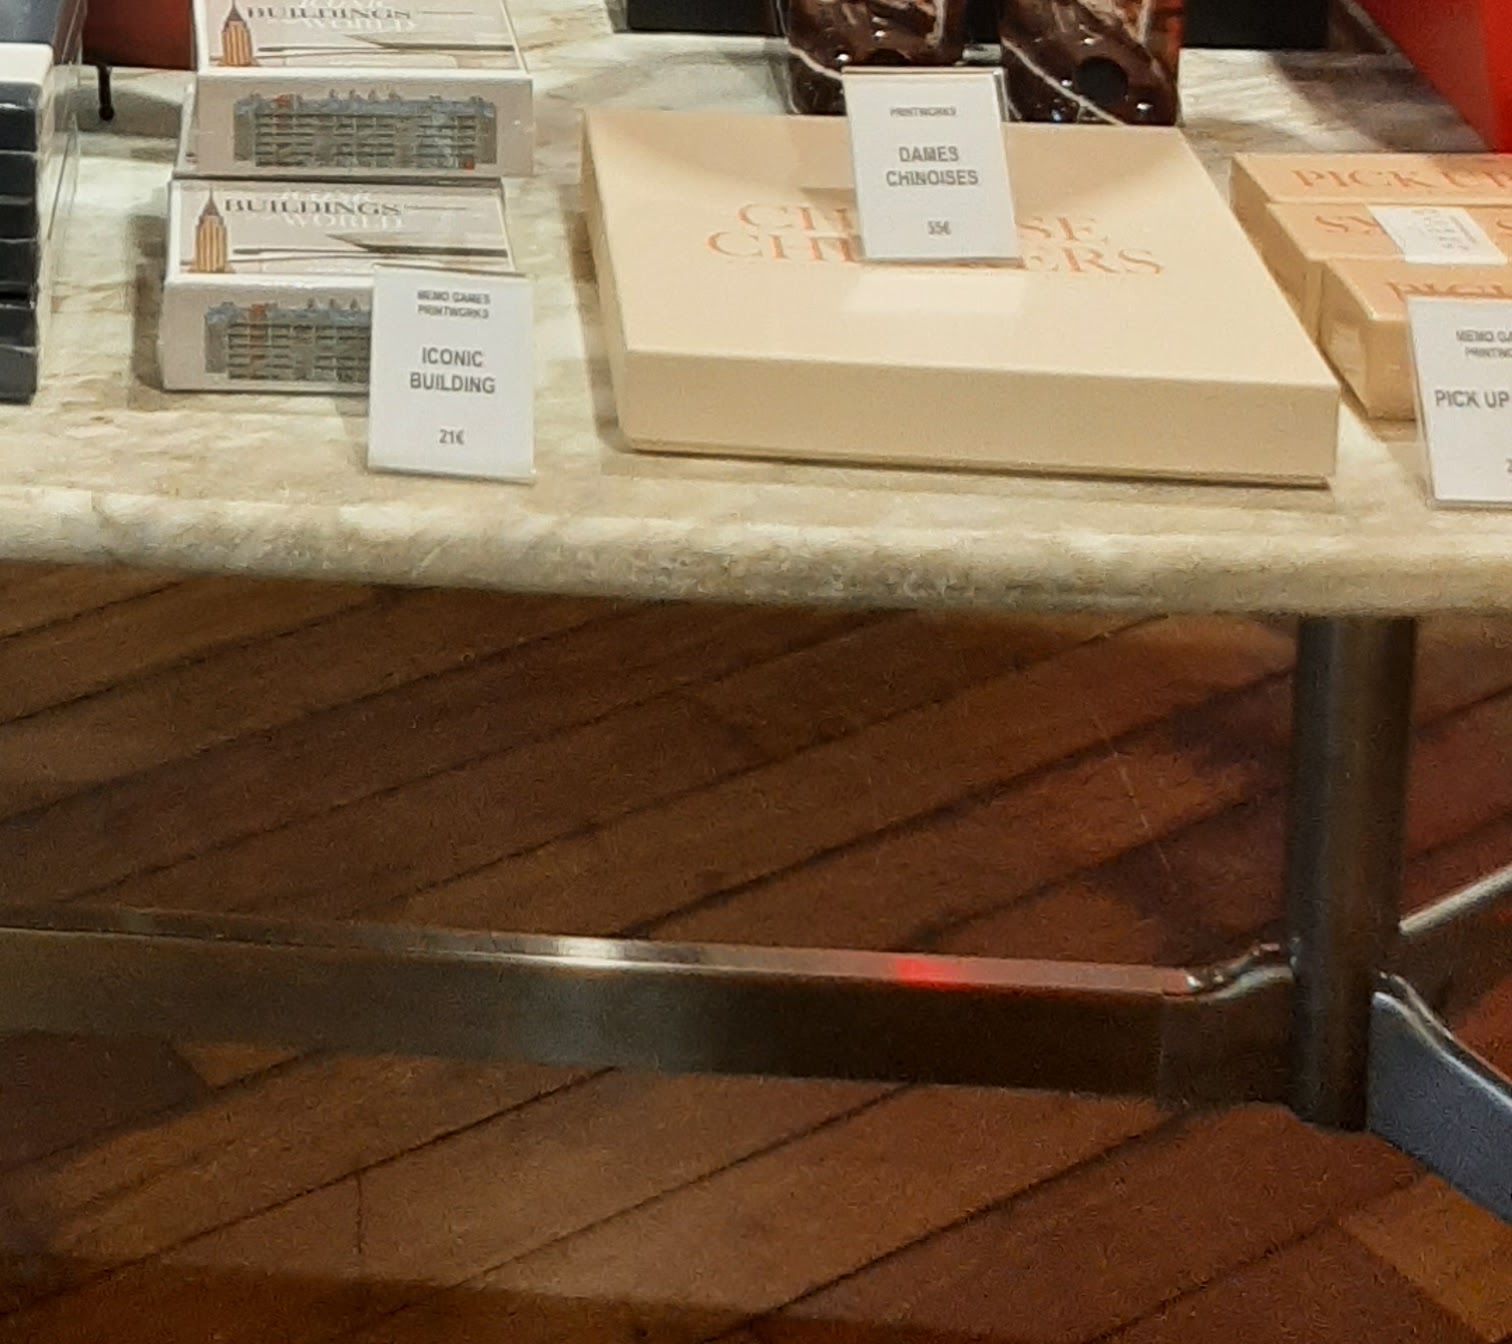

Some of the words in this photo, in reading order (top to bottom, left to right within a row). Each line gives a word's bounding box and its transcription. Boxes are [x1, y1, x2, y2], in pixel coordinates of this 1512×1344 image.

[246, 6, 412, 20] BUILDINGS
[898, 146, 960, 162] DAMES
[885, 169, 980, 187] CHINOISES
[1292, 169, 1438, 189] PICK
[223, 198, 402, 216] BUILDINGS
[421, 347, 484, 368] ICONIC
[409, 372, 496, 394] BUILDING
[1433, 388, 1481, 409] PICK
[1483, 389, 1511, 410] UP
[438, 429, 465, 445] 21€
